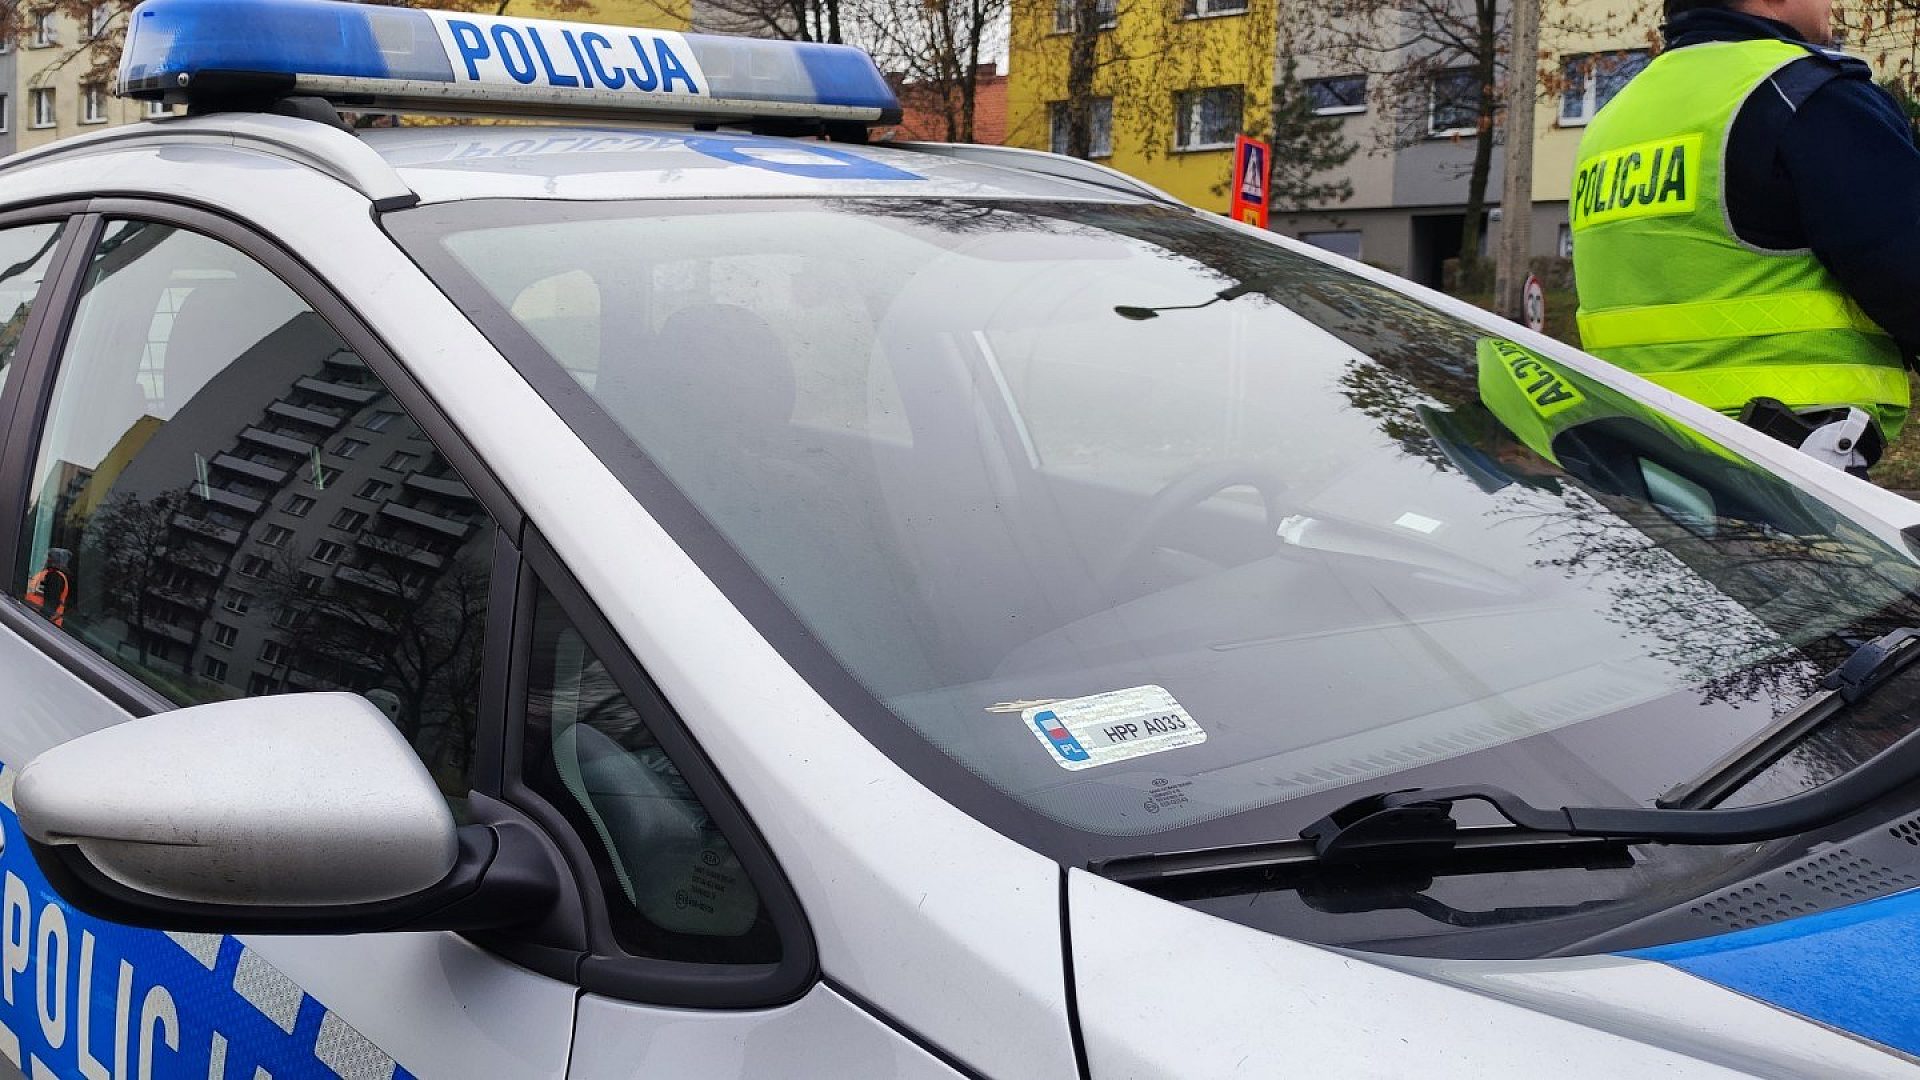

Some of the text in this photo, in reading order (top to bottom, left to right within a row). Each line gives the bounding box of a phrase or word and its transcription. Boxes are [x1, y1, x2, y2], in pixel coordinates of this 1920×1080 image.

[447, 19, 700, 94] POLICJA
[1574, 145, 1686, 221] POLICJA
[1061, 743, 1083, 755] PL
[1103, 723, 1138, 743] HPP
[1143, 714, 1186, 736] A033
[3, 869, 273, 1080] POLIC
